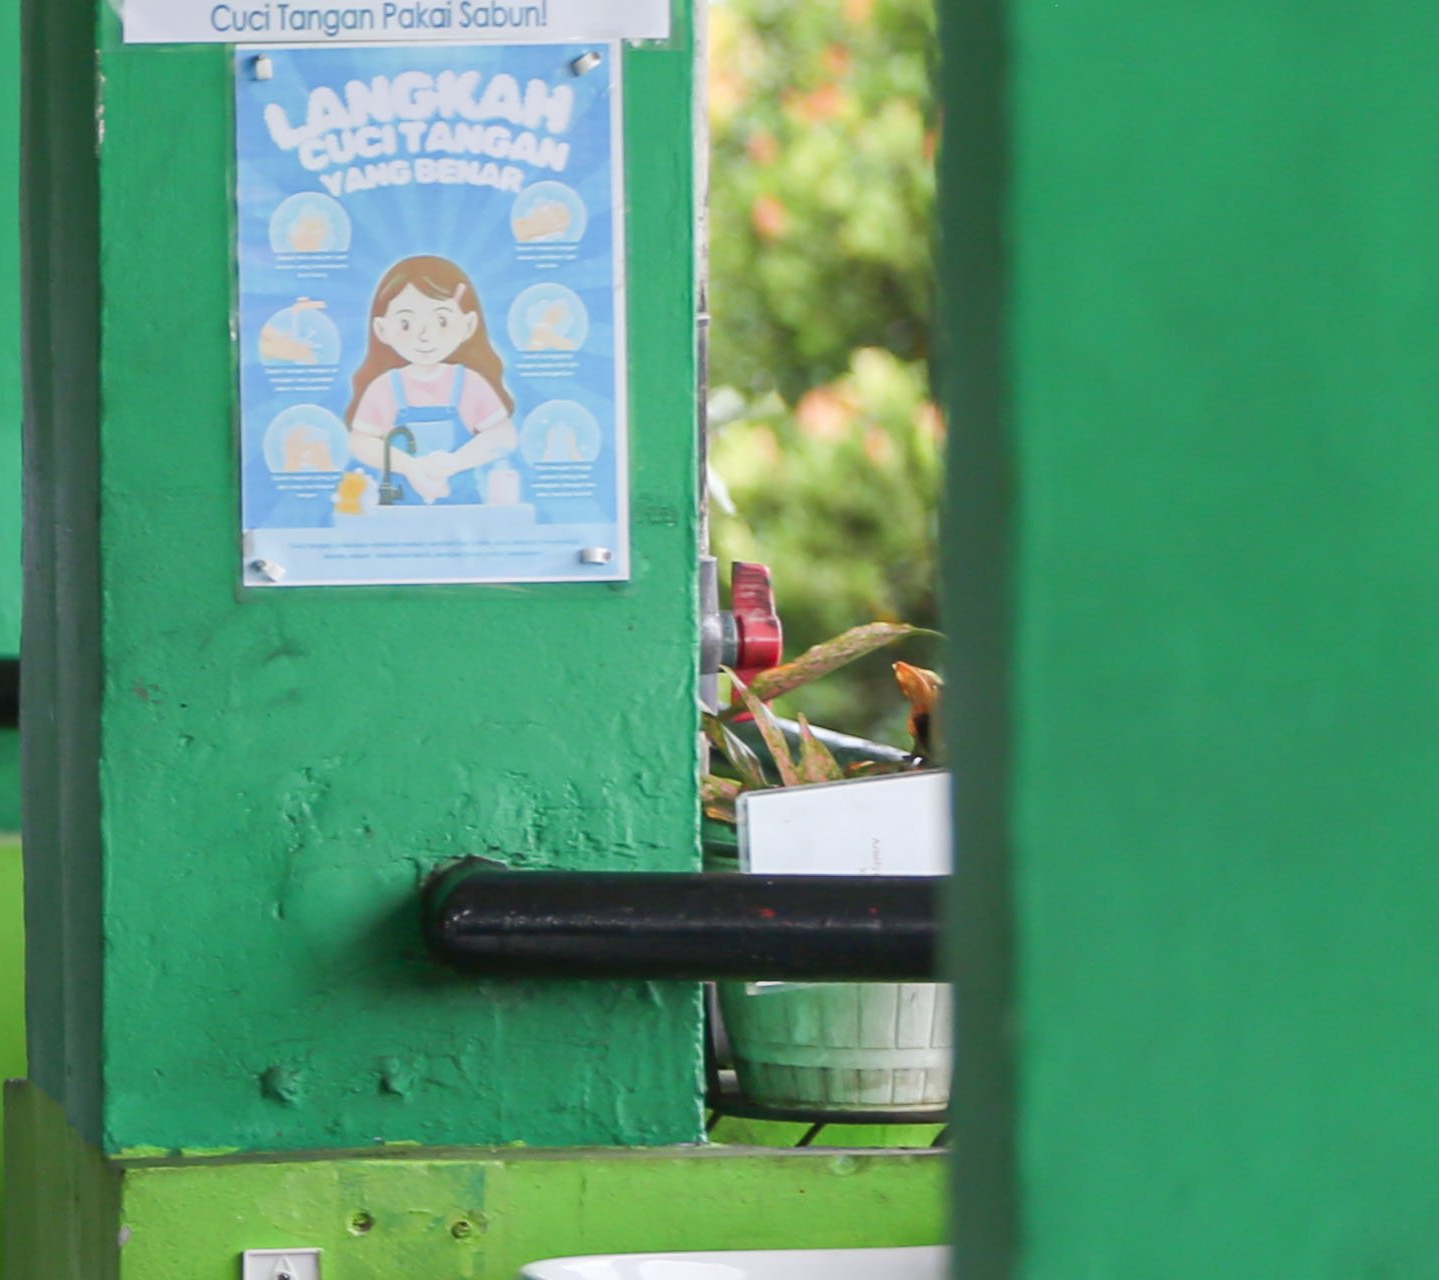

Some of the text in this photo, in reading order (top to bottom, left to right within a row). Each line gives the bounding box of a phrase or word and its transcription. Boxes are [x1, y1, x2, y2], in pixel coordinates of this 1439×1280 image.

[210, 0, 548, 37] Cuci Tangan Pakai Sabun!
[264, 70, 574, 150] LANGKAH
[298, 120, 570, 172] CUCI TANGAN
[319, 158, 525, 197] YANG BENAR
